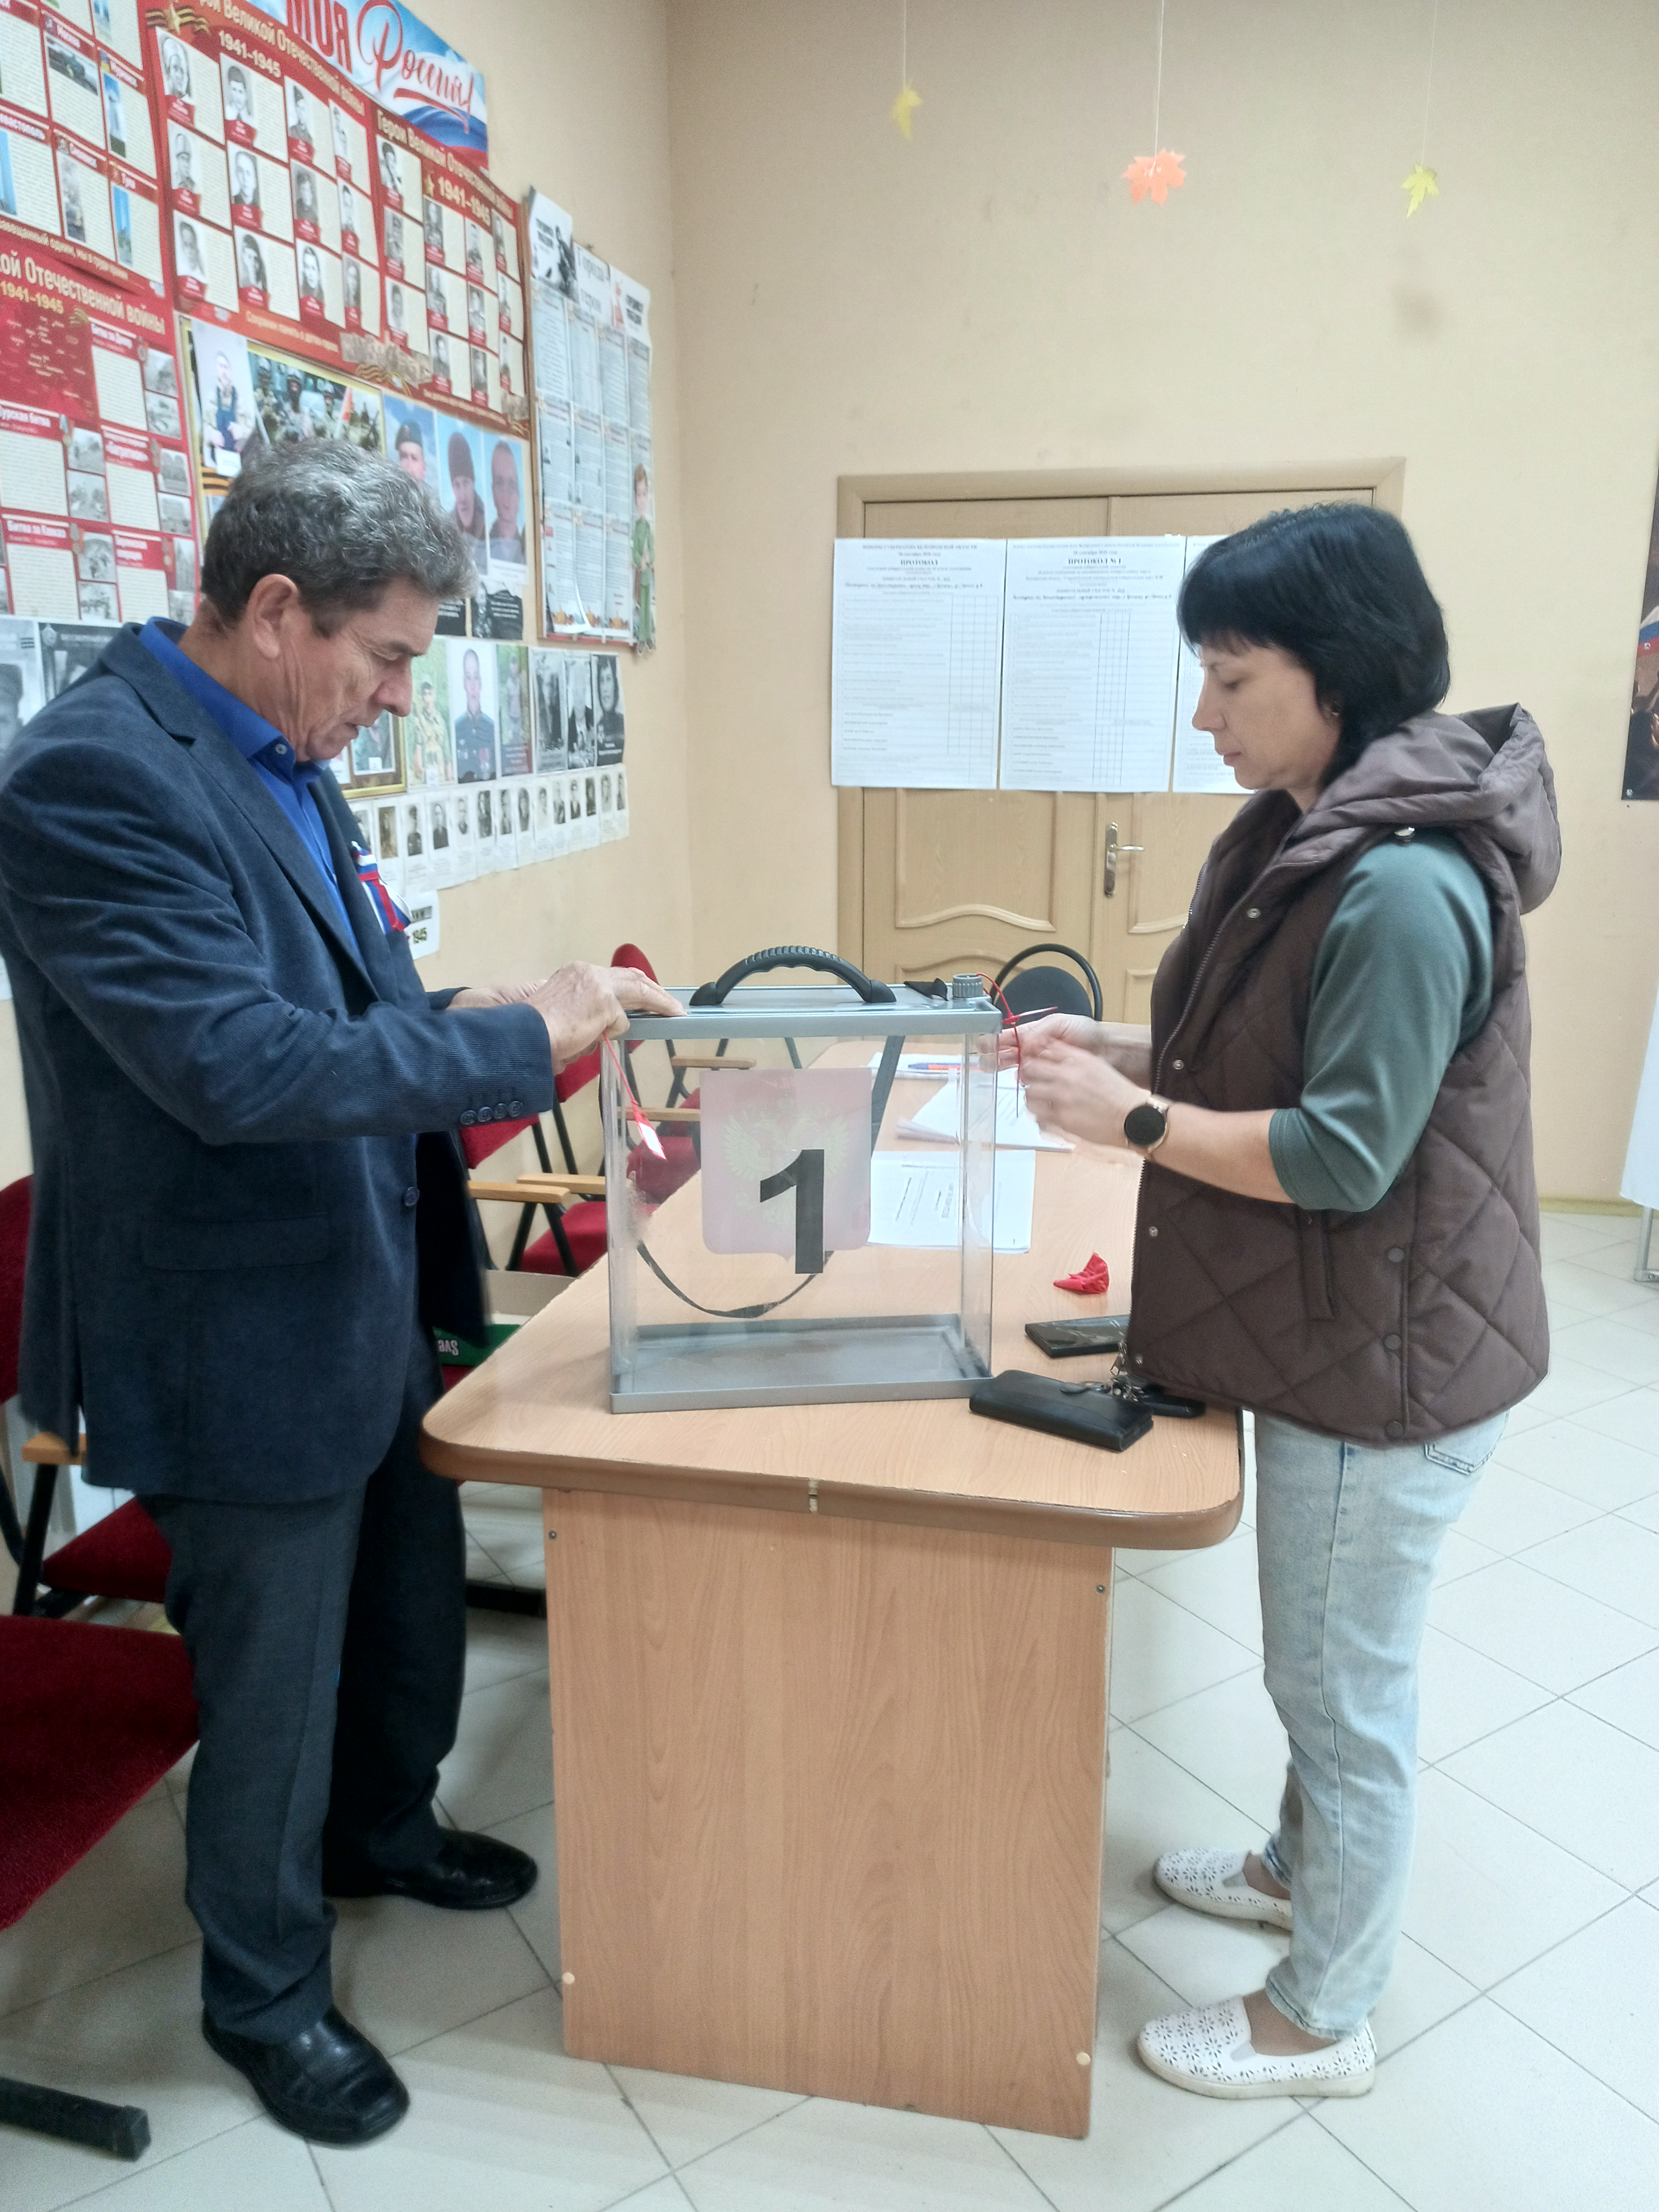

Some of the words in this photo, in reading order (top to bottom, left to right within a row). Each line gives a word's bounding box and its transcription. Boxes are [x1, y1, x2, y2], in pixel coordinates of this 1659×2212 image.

[218, 30, 282, 78] 1941-1945
[223, 0, 276, 46] Великой
[277, 29, 341, 97] Отечественной
[0, 250, 22, 279] ой
[24, 256, 125, 320] Отечественной
[125, 304, 165, 335] войны
[0, 280, 64, 314] 1941-1945
[760, 1149, 824, 1274] 1
